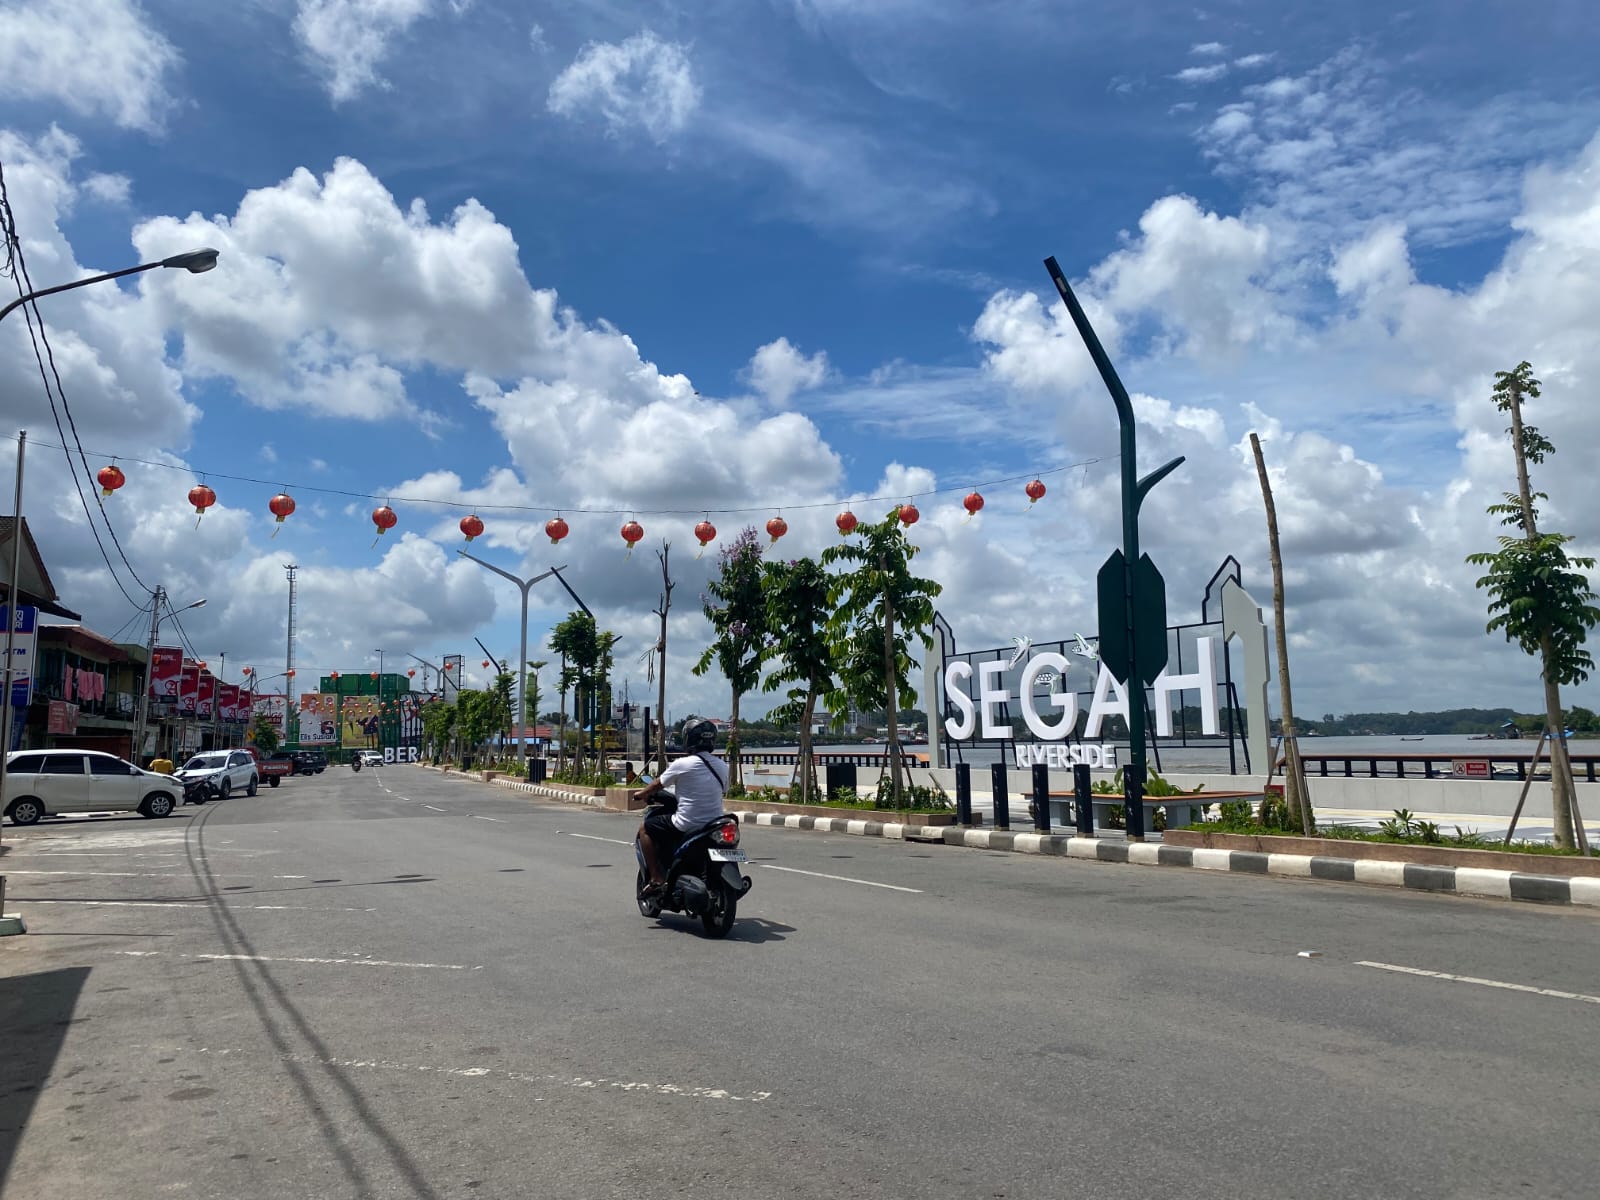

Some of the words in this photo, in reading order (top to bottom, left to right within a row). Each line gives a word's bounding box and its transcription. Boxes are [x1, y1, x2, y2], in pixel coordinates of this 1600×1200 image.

[945, 636, 1220, 740] SEGAH
[384, 746, 424, 762] BER
[1015, 744, 1116, 770] RIVERSIDE
